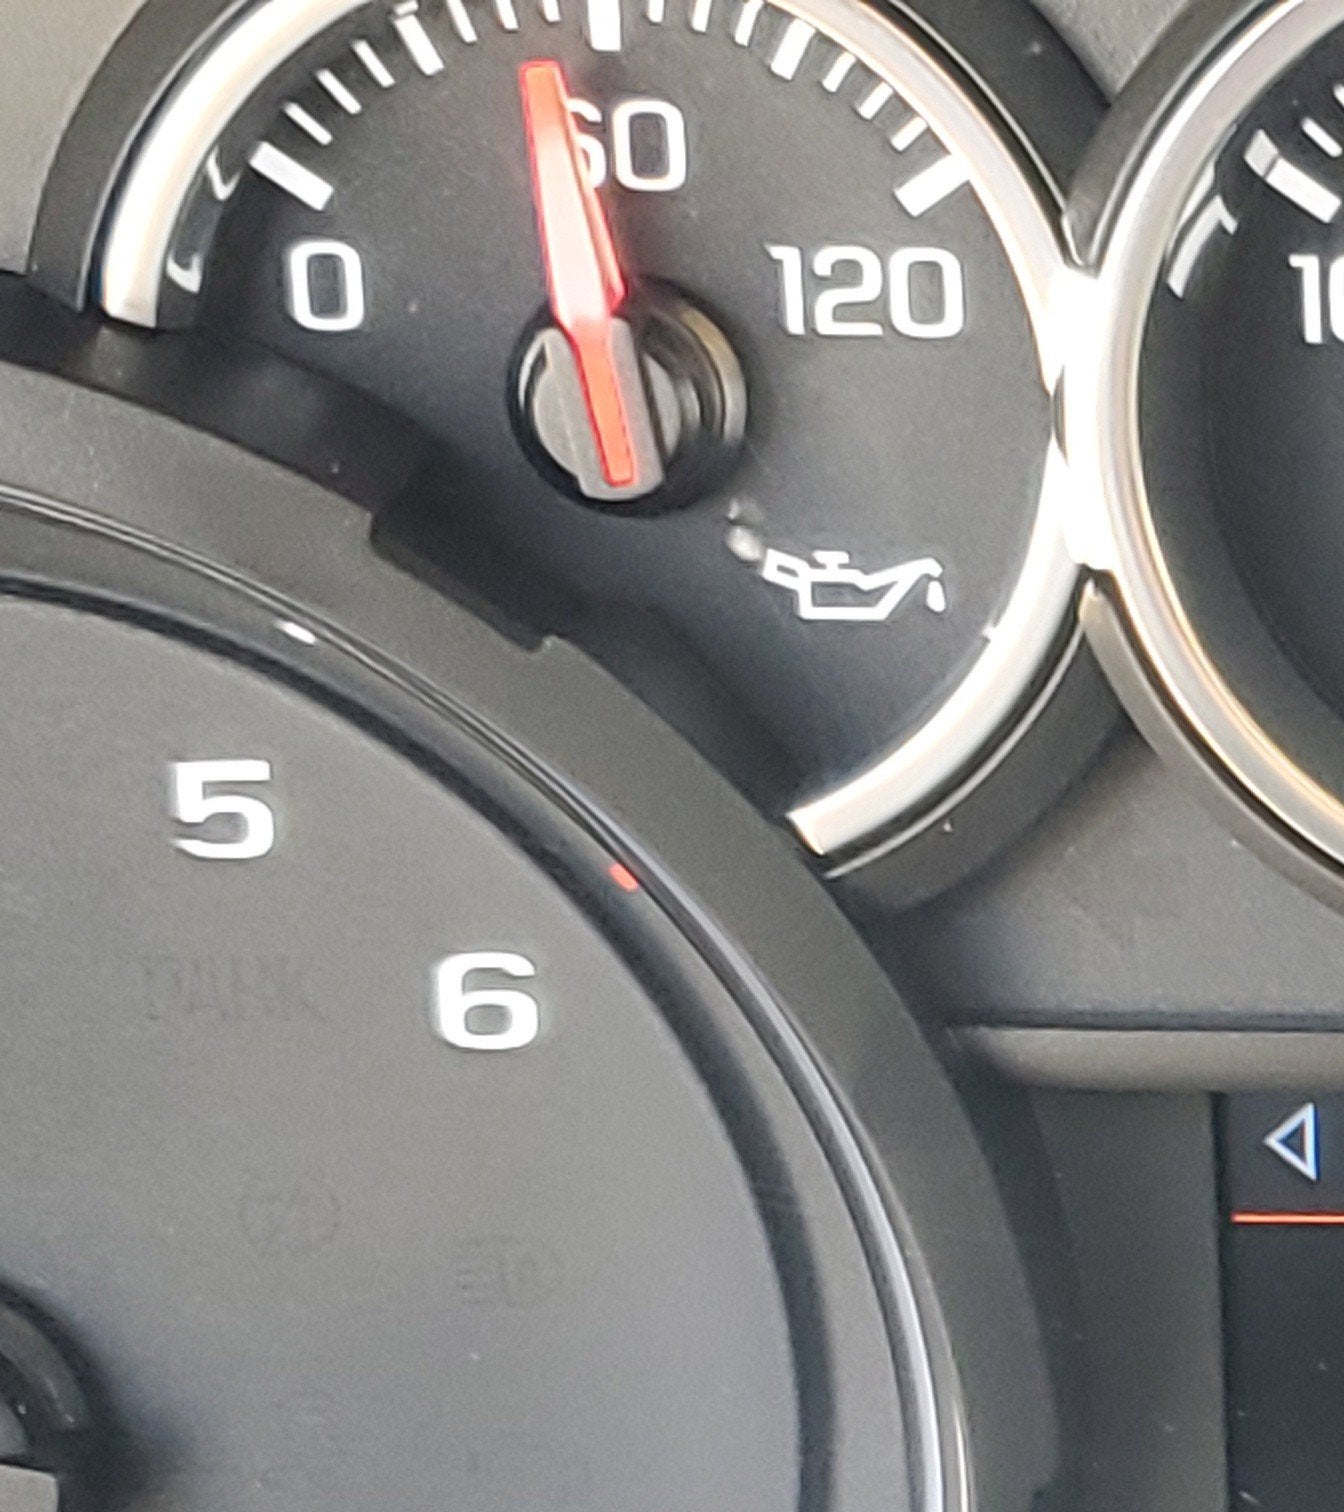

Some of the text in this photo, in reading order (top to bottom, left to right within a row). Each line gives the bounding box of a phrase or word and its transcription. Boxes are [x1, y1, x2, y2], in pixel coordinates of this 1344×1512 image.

[286, 239, 366, 332] 0
[764, 244, 966, 338] 120
[168, 759, 277, 860] 5
[434, 951, 541, 1051] 6
